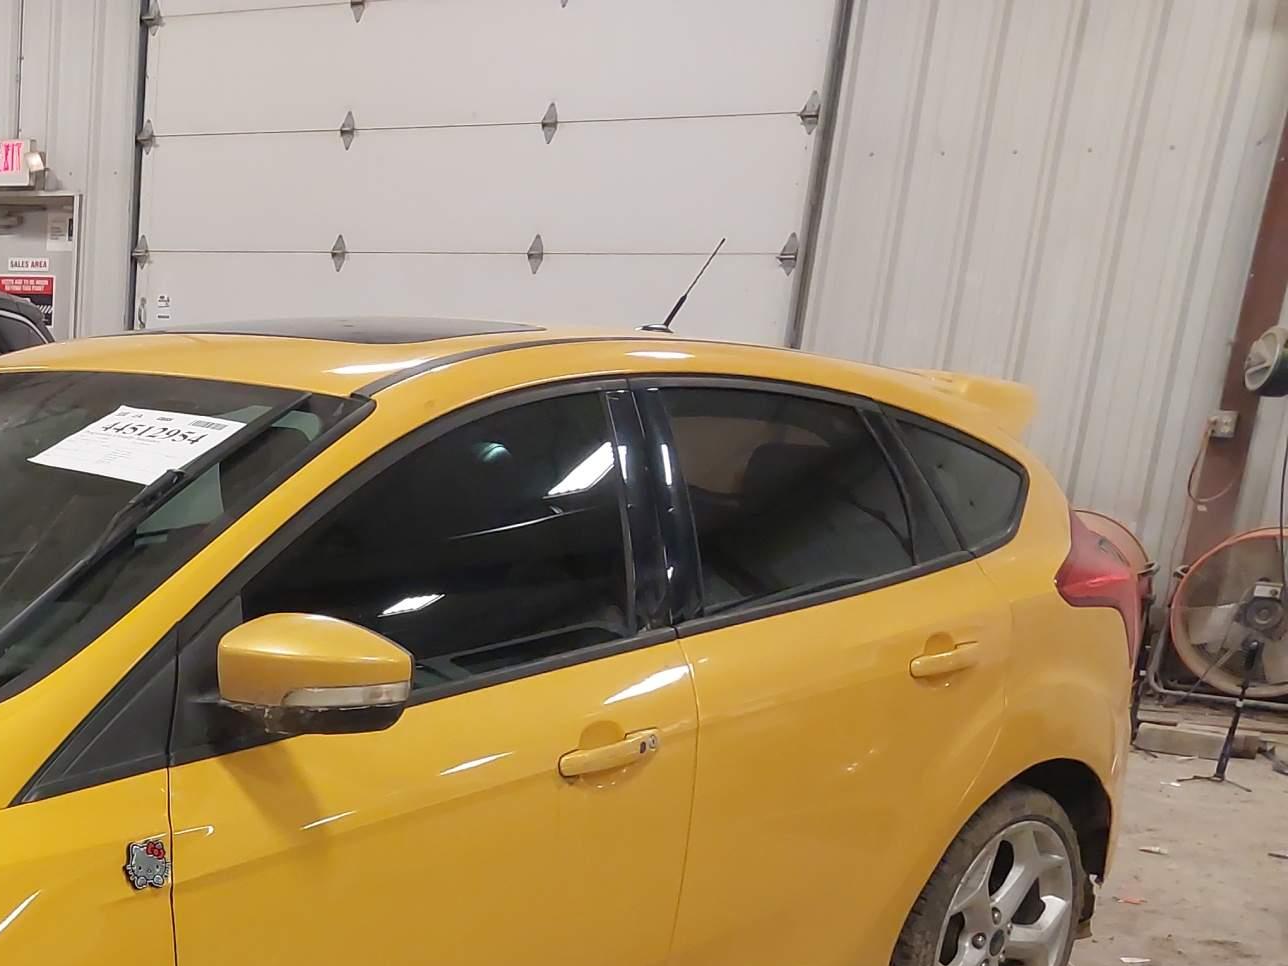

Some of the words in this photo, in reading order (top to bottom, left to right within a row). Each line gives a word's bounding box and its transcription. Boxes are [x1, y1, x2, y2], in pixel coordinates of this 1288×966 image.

[10, 260, 29, 268] SALES
[31, 260, 47, 268] AREA
[101, 421, 209, 446] 44512954
